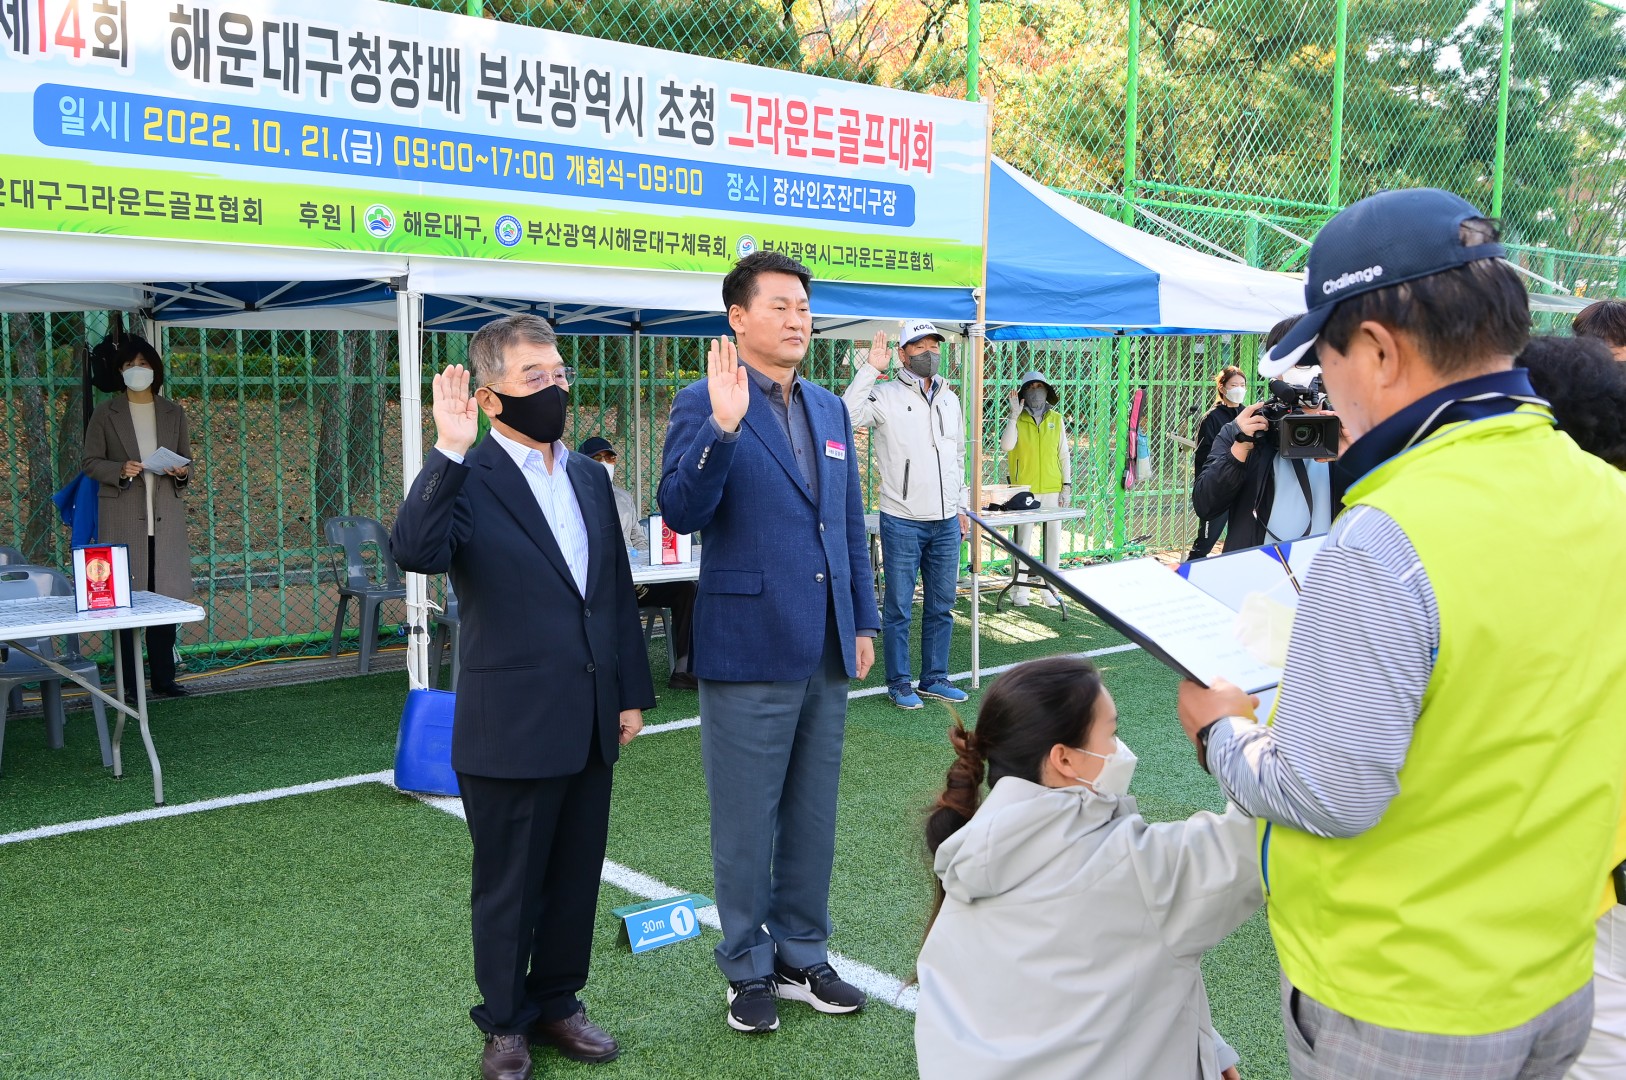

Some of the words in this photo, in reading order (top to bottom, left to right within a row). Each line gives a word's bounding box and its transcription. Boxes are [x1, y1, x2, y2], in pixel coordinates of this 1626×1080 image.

[169, 4, 461, 114] 해운대구청장배
[477, 52, 643, 137] 부산광역시
[658, 80, 715, 146] 초청
[729, 94, 933, 173] 그라운드골프대회
[144, 107, 240, 150] 2022.
[253, 119, 290, 156] 10.
[302, 126, 383, 166] 21.(금)
[393, 136, 554, 180] 09:00~17:00
[567, 155, 704, 196] 개회식-09:00
[773, 179, 897, 217] 장산인조잔디구장
[0, 178, 263, 225] 대구그라운드골프협회
[299, 202, 341, 232] 후원
[1322, 265, 1383, 295] Challenge
[641, 919, 665, 934] 30m
[676, 909, 688, 932] 1
